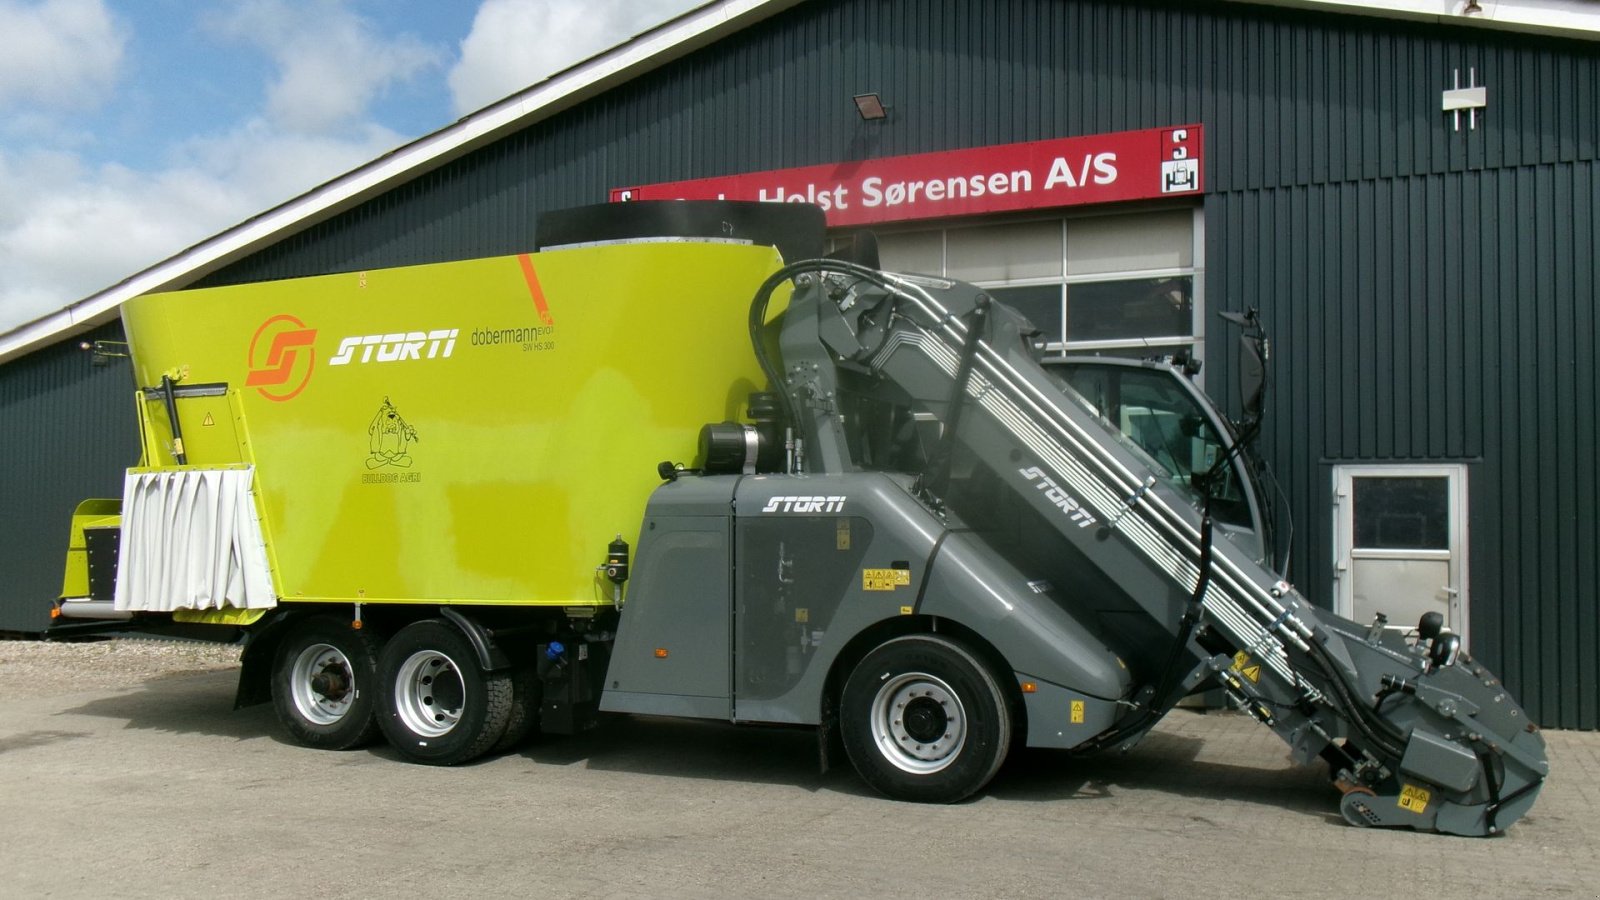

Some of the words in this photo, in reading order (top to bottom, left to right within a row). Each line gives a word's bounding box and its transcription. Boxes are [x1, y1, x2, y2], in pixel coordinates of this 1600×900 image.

[862, 170, 1032, 207] Sørensen
[1044, 152, 1118, 190] A/S
[329, 328, 460, 366] STORTI
[471, 327, 537, 346] dobermann
[362, 473, 399, 484] BULLDOG
[400, 472, 421, 483] AGRI
[762, 496, 847, 513] STORTI
[1019, 466, 1097, 528] STORTI
